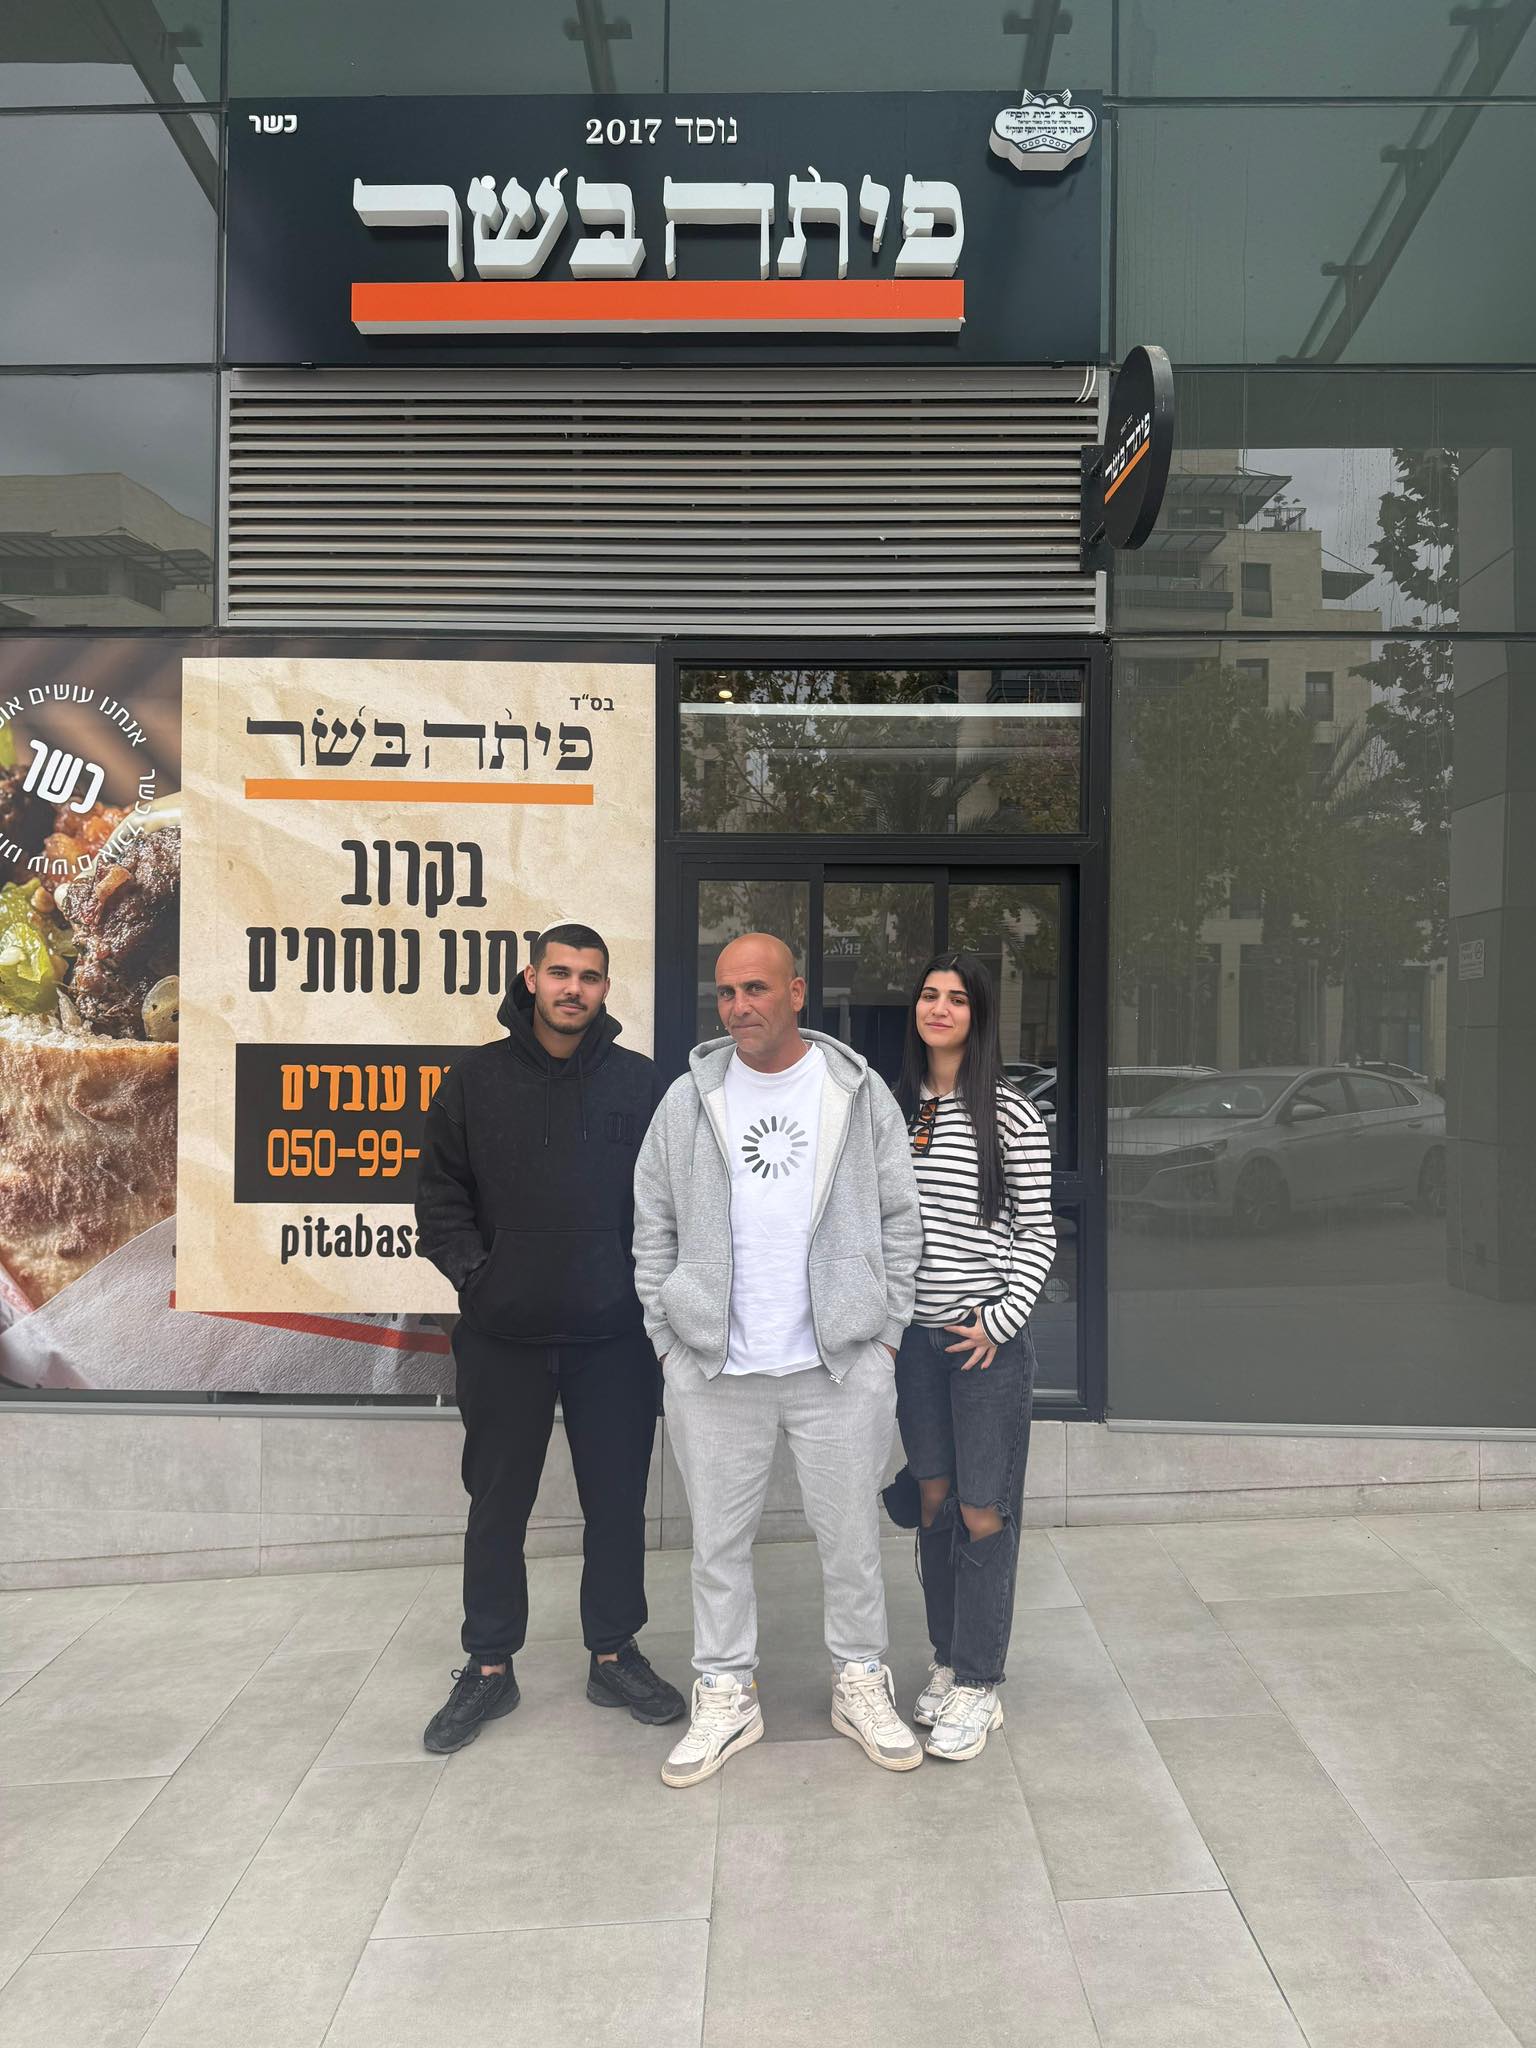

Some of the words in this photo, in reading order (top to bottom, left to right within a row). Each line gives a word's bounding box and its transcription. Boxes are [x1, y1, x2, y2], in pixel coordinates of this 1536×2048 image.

[248, 114, 298, 134] כשר
[585, 118, 663, 145] 2017
[674, 116, 738, 144] נוסד
[28, 684, 95, 705] עושים
[569, 693, 615, 711] בס"ד
[99, 696, 147, 748] אנחנו
[22, 739, 105, 814] כשר
[27, 854, 94, 875] עושים
[98, 820, 144, 863] אוכל
[134, 768, 156, 815] כשר
[341, 839, 488, 918] בקרוב
[245, 926, 421, 995] נוחתים
[280, 1064, 407, 1112] עובדים
